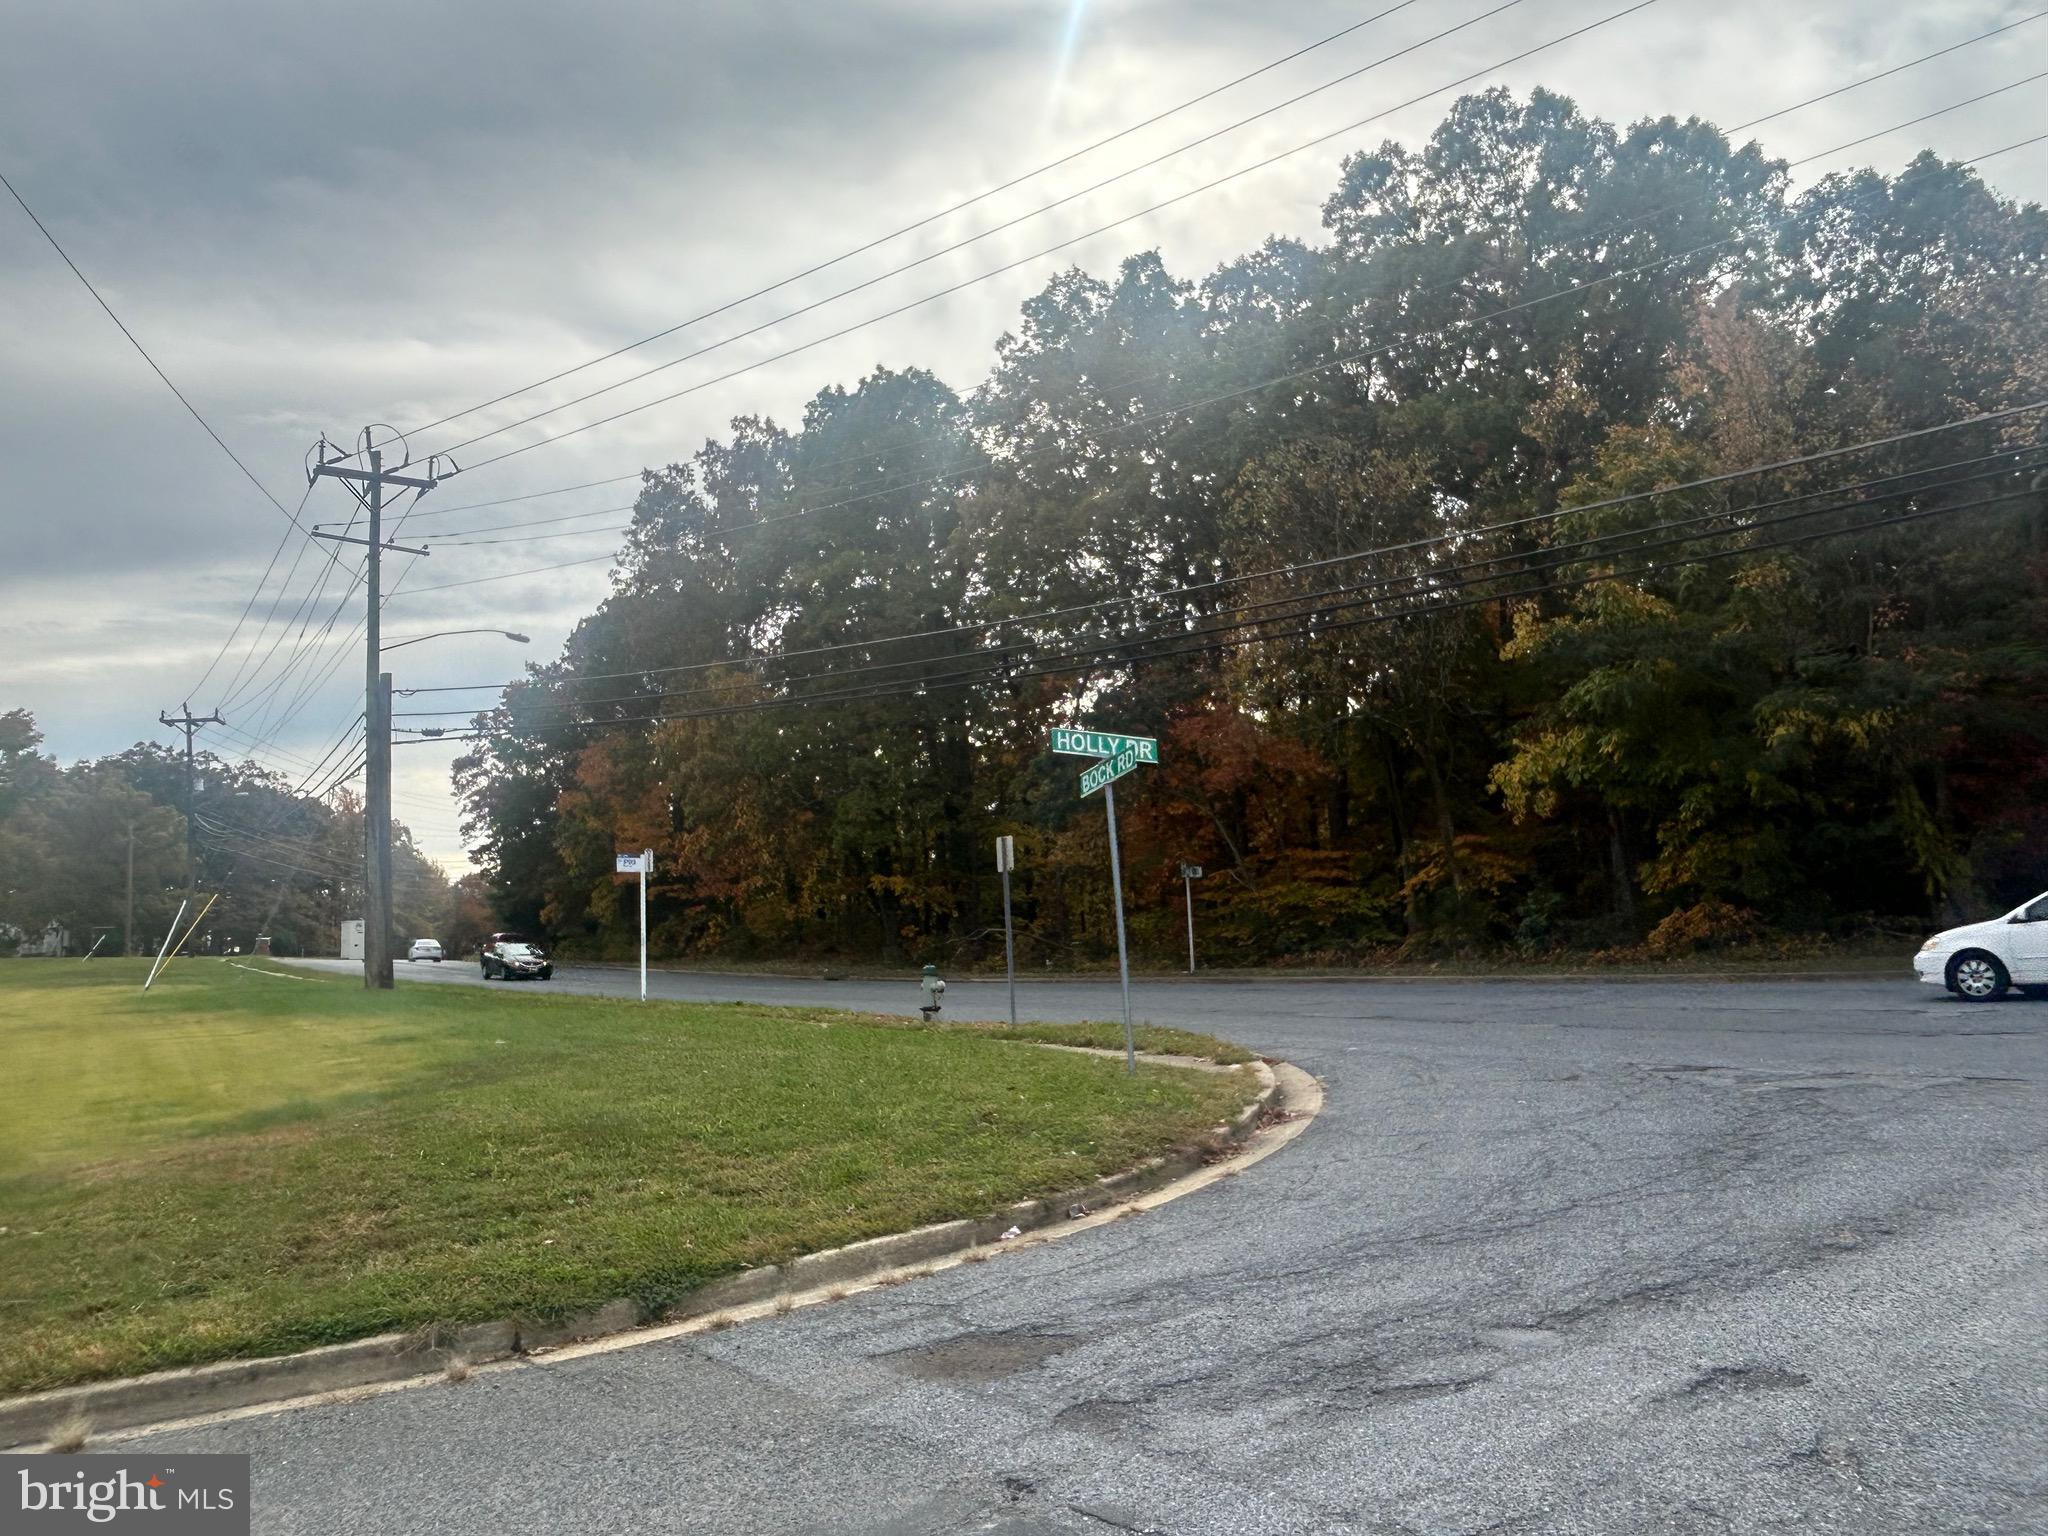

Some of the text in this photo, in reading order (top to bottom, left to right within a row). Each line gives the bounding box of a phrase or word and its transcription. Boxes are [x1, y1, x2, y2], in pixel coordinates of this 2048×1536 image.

[1057, 732, 1153, 759] HOLLY DR
[1082, 750, 1133, 792] BOCK RD
